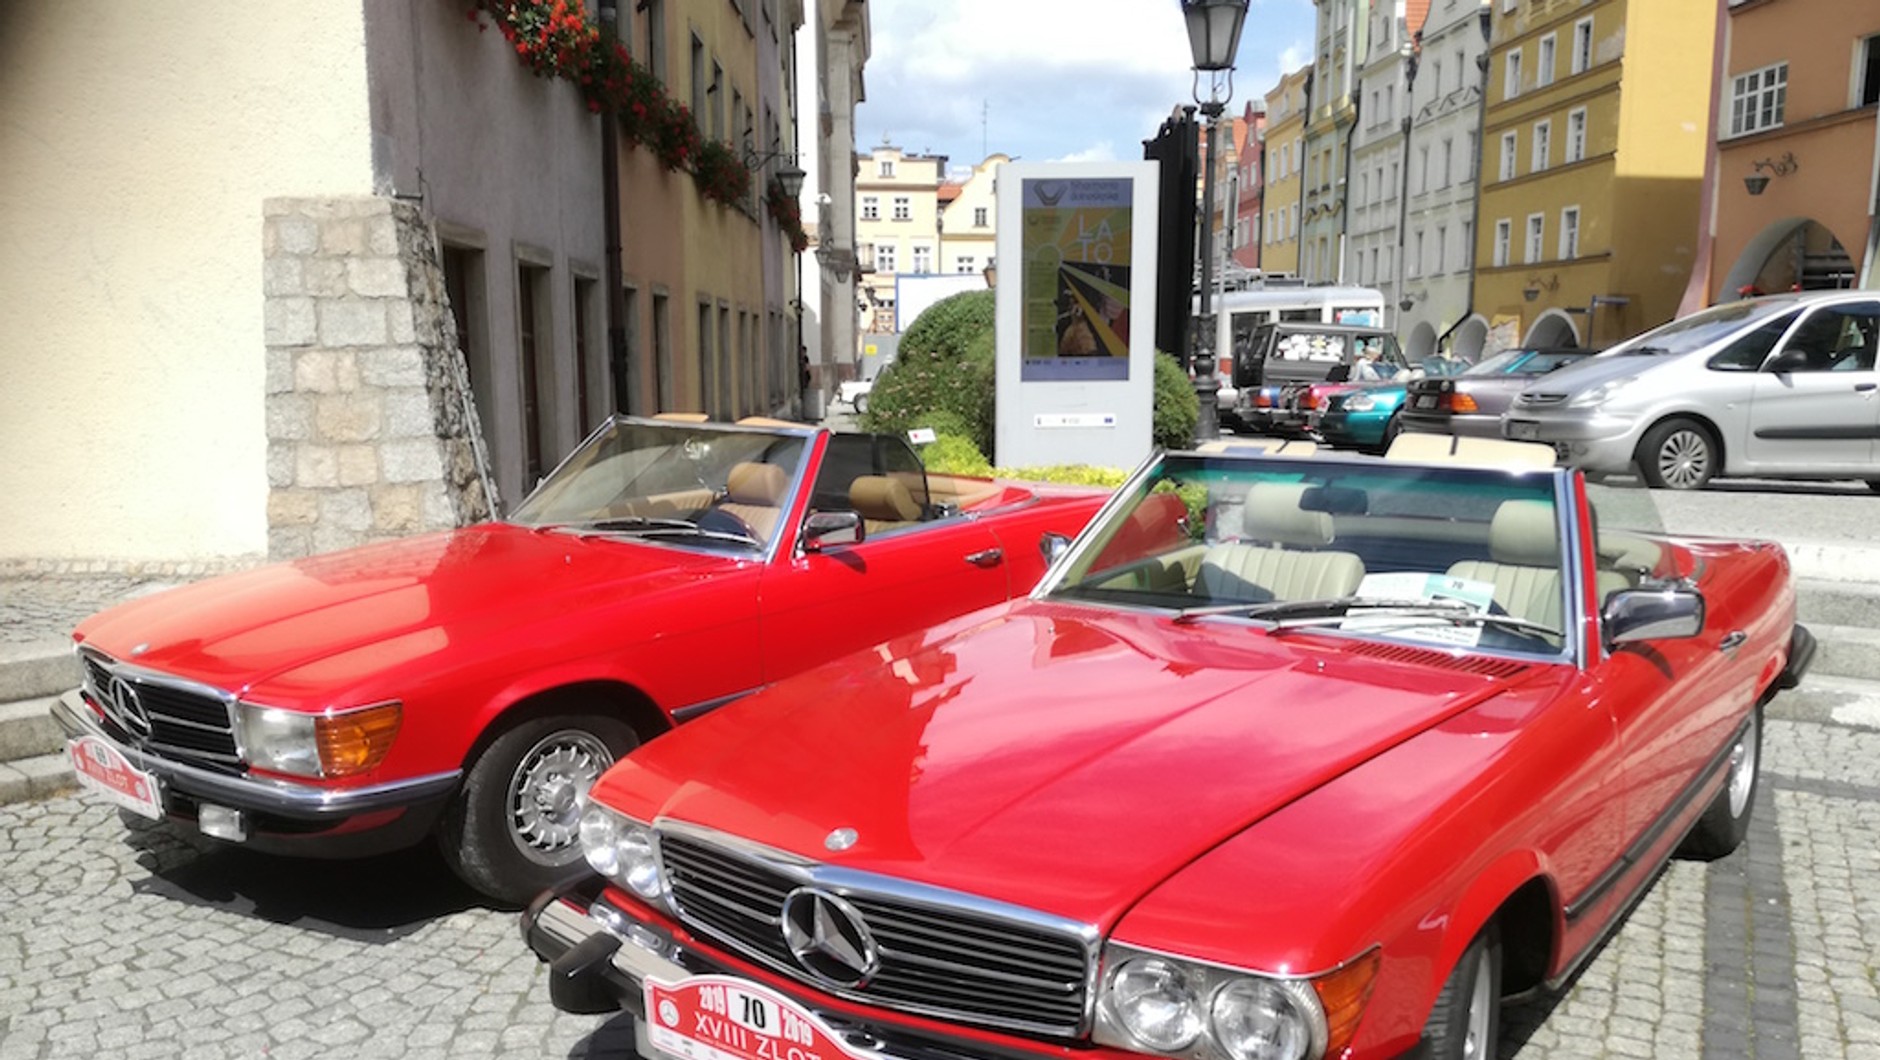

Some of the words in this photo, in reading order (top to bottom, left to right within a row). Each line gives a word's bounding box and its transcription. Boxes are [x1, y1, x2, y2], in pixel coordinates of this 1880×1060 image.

[694, 1011, 747, 1050] XVIII
[699, 986, 727, 1016] 2019
[739, 994, 766, 1029] 70
[782, 1010, 813, 1047] 2019
